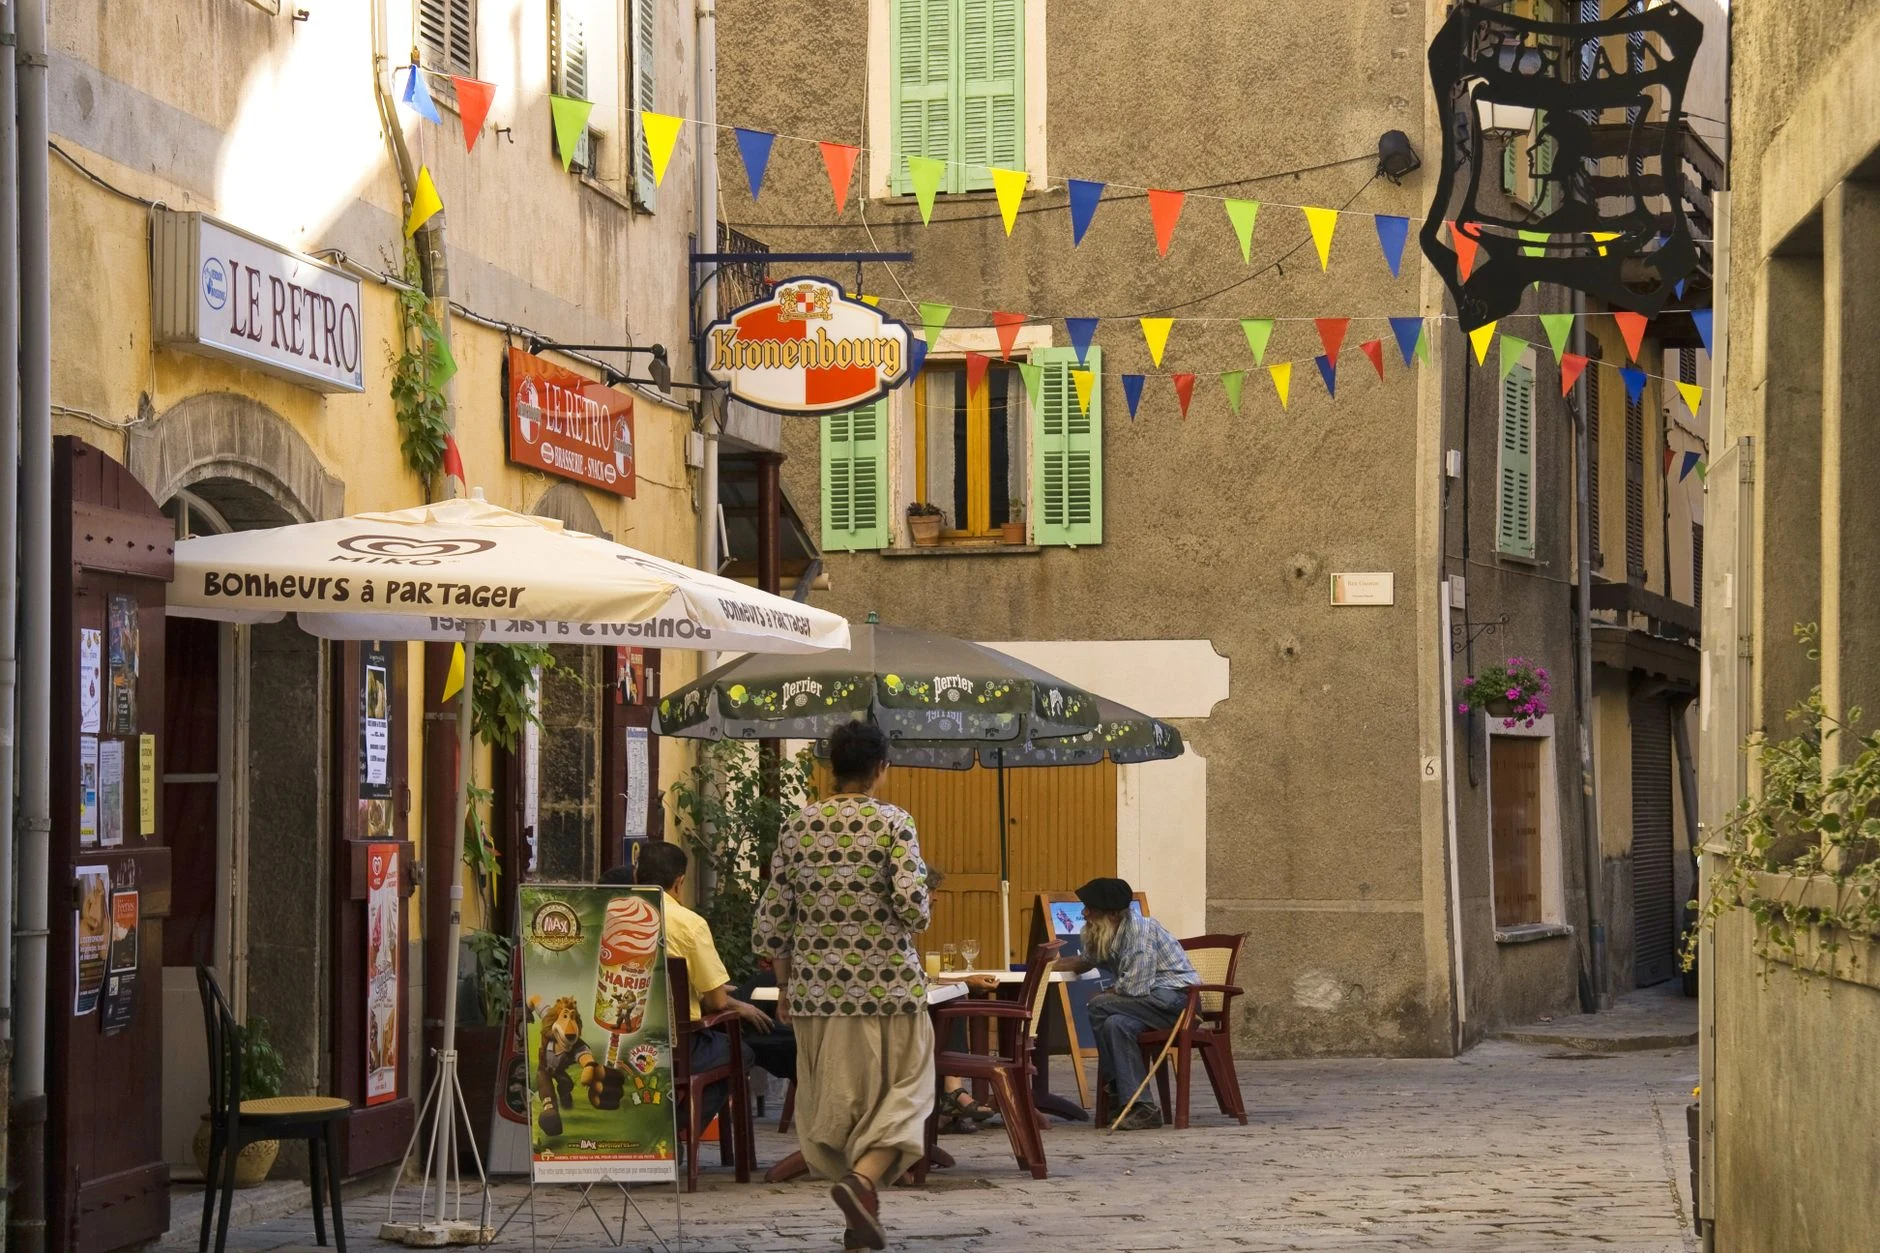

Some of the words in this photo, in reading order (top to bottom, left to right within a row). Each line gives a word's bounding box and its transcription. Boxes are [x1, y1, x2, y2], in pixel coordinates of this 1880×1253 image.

[229, 259, 263, 342] LE
[269, 265, 358, 373] RÉTRO
[711, 326, 901, 377] Kronenbourg
[544, 382, 563, 434] LE
[564, 380, 611, 451] RÉTRO
[554, 446, 584, 475] BRASSERIE
[587, 457, 605, 481] SNACK
[328, 555, 442, 566] MIKO
[360, 579, 374, 602] à
[1425, 759, 1434, 775] 6
[544, 916, 568, 933] MAX
[631, 1045, 657, 1056] HARIBO
